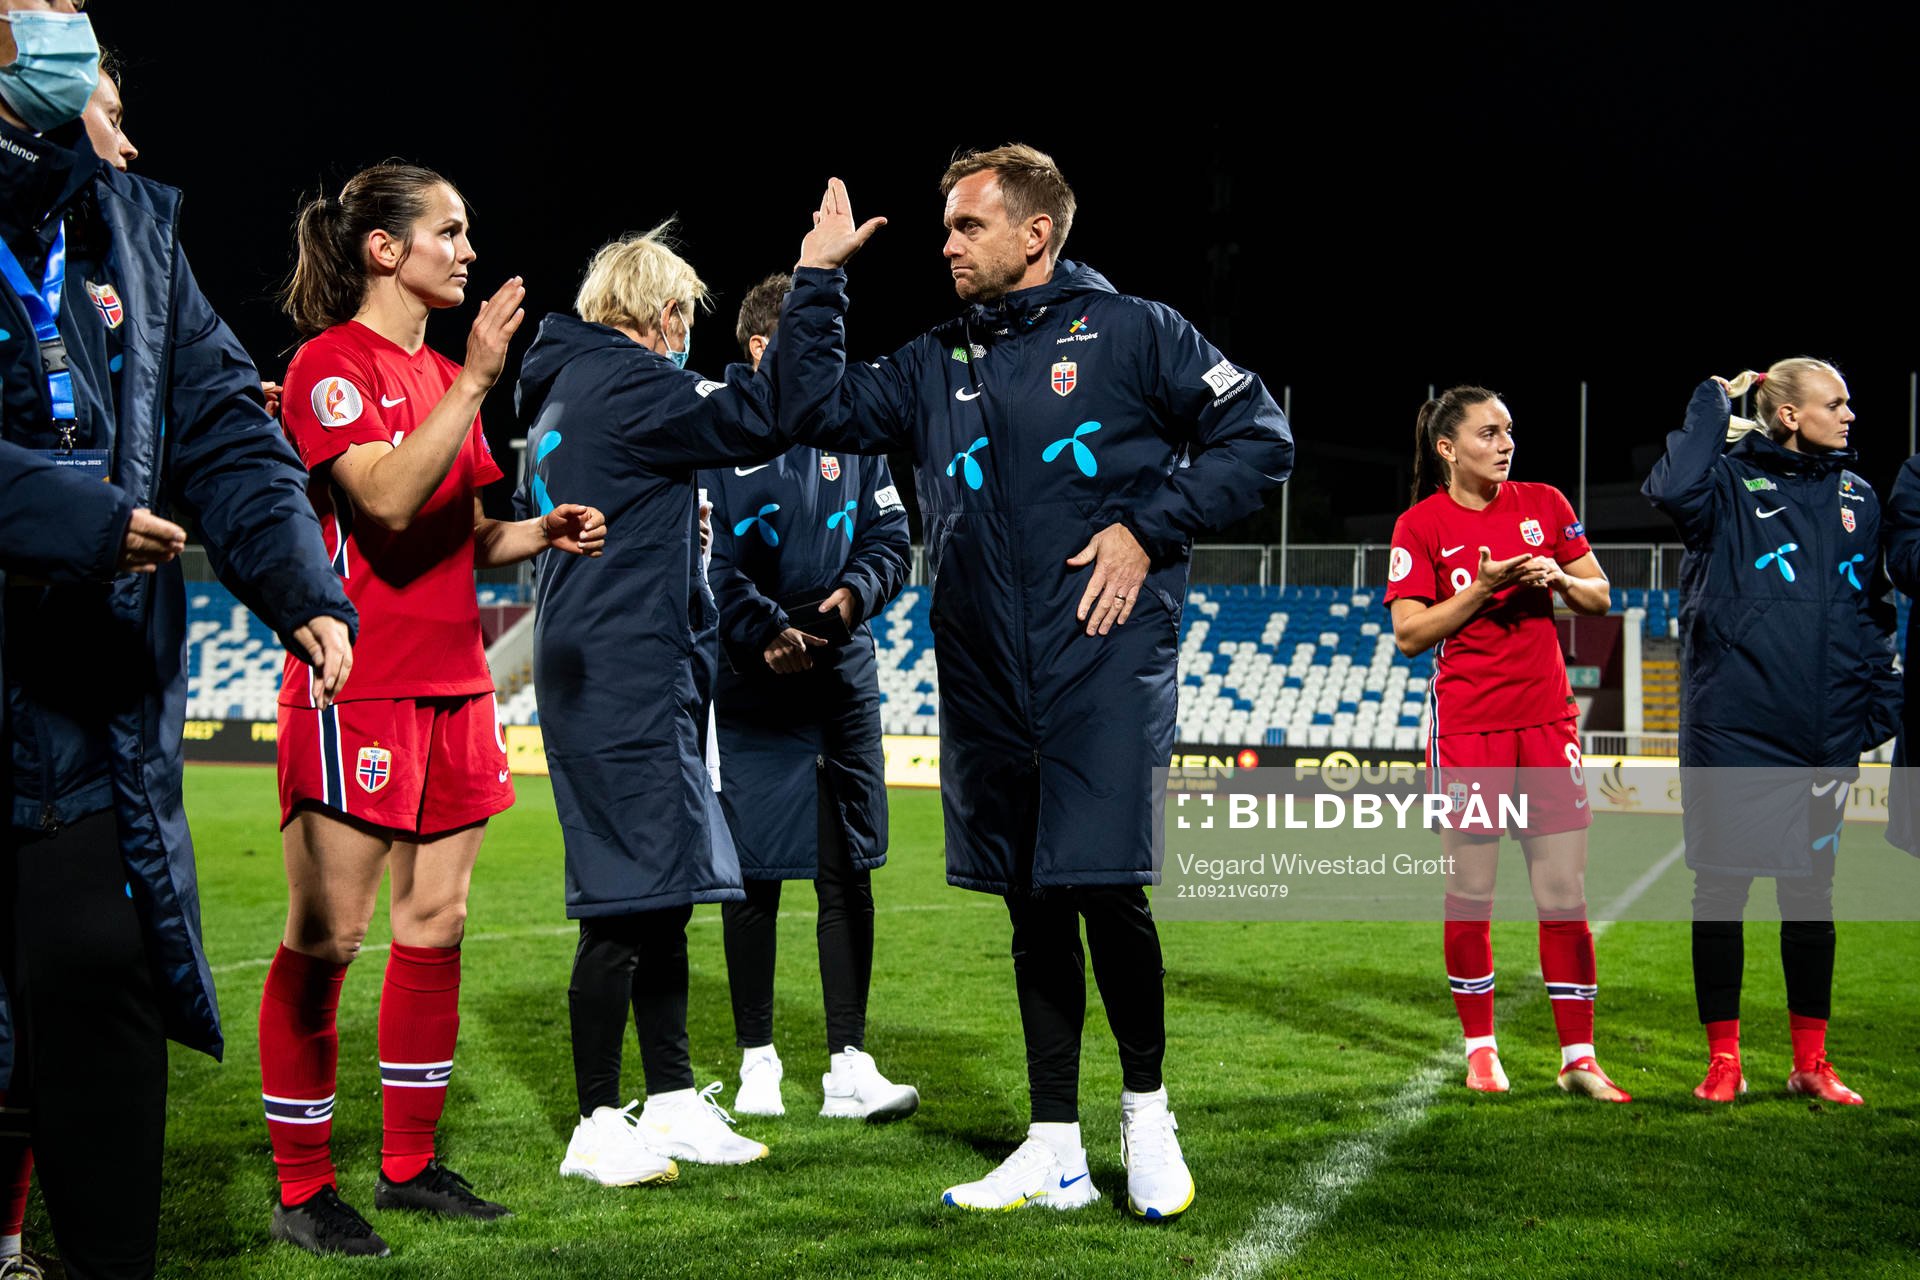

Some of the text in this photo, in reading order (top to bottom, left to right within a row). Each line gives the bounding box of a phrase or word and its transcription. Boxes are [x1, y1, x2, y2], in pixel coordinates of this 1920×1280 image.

[0, 134, 39, 163] elenor
[1056, 335, 1075, 345] Norsk
[1564, 742, 1584, 786] 8
